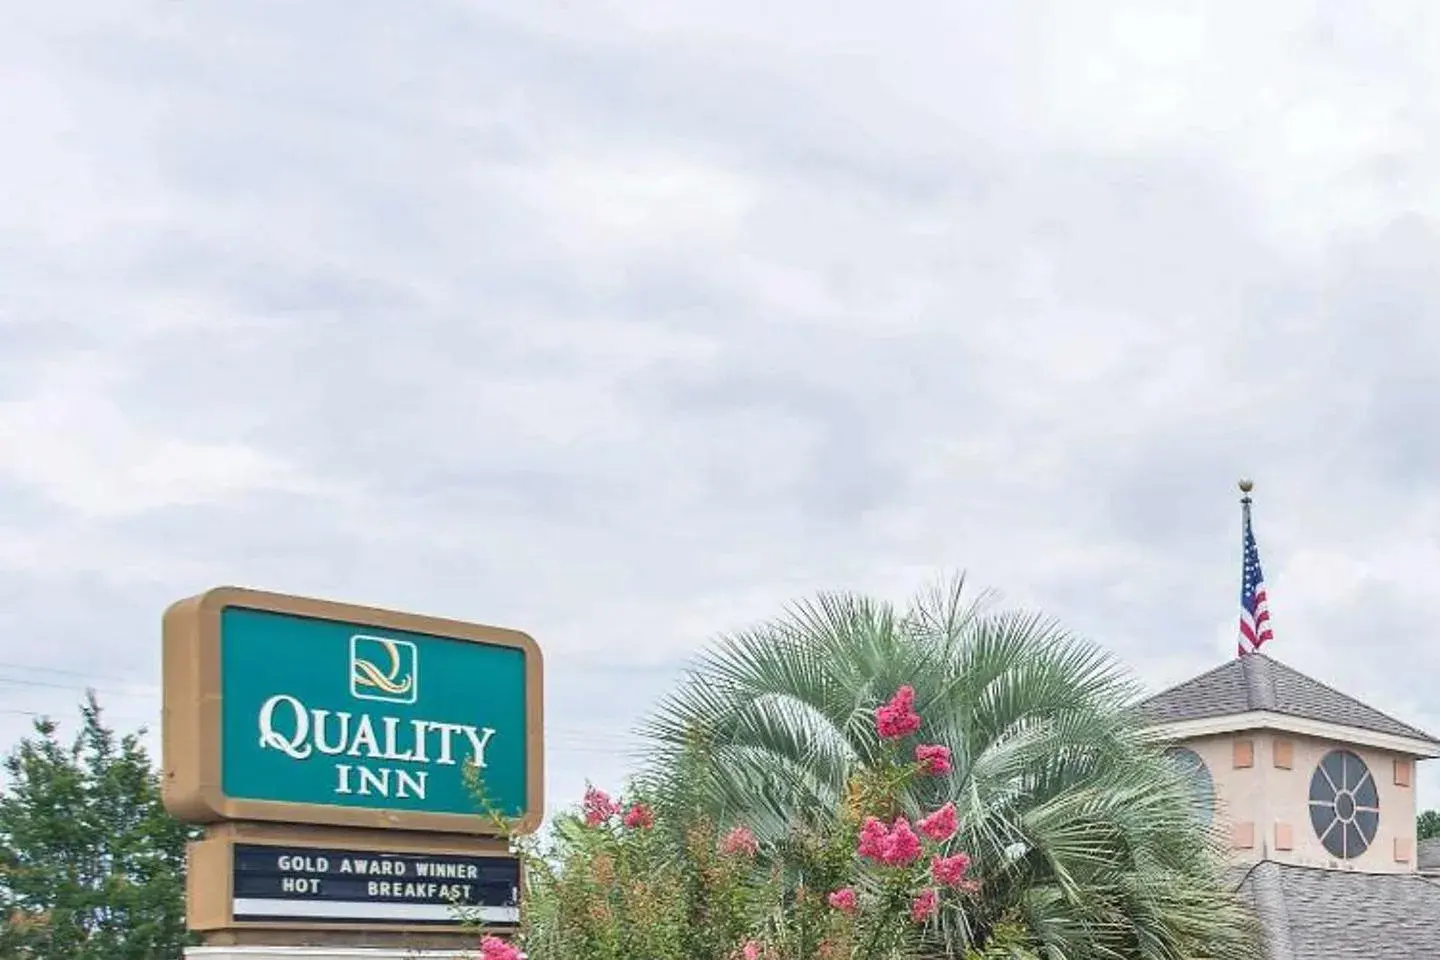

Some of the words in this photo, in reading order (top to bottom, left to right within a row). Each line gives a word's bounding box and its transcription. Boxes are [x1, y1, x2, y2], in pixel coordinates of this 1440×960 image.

[259, 694, 496, 768] QUALITY
[334, 764, 429, 800] INN
[277, 855, 329, 872] GOLD
[340, 858, 406, 876] AWARD
[416, 862, 478, 879] WINNER
[282, 878, 321, 894] HOT
[367, 881, 473, 899] BREAKFAST
